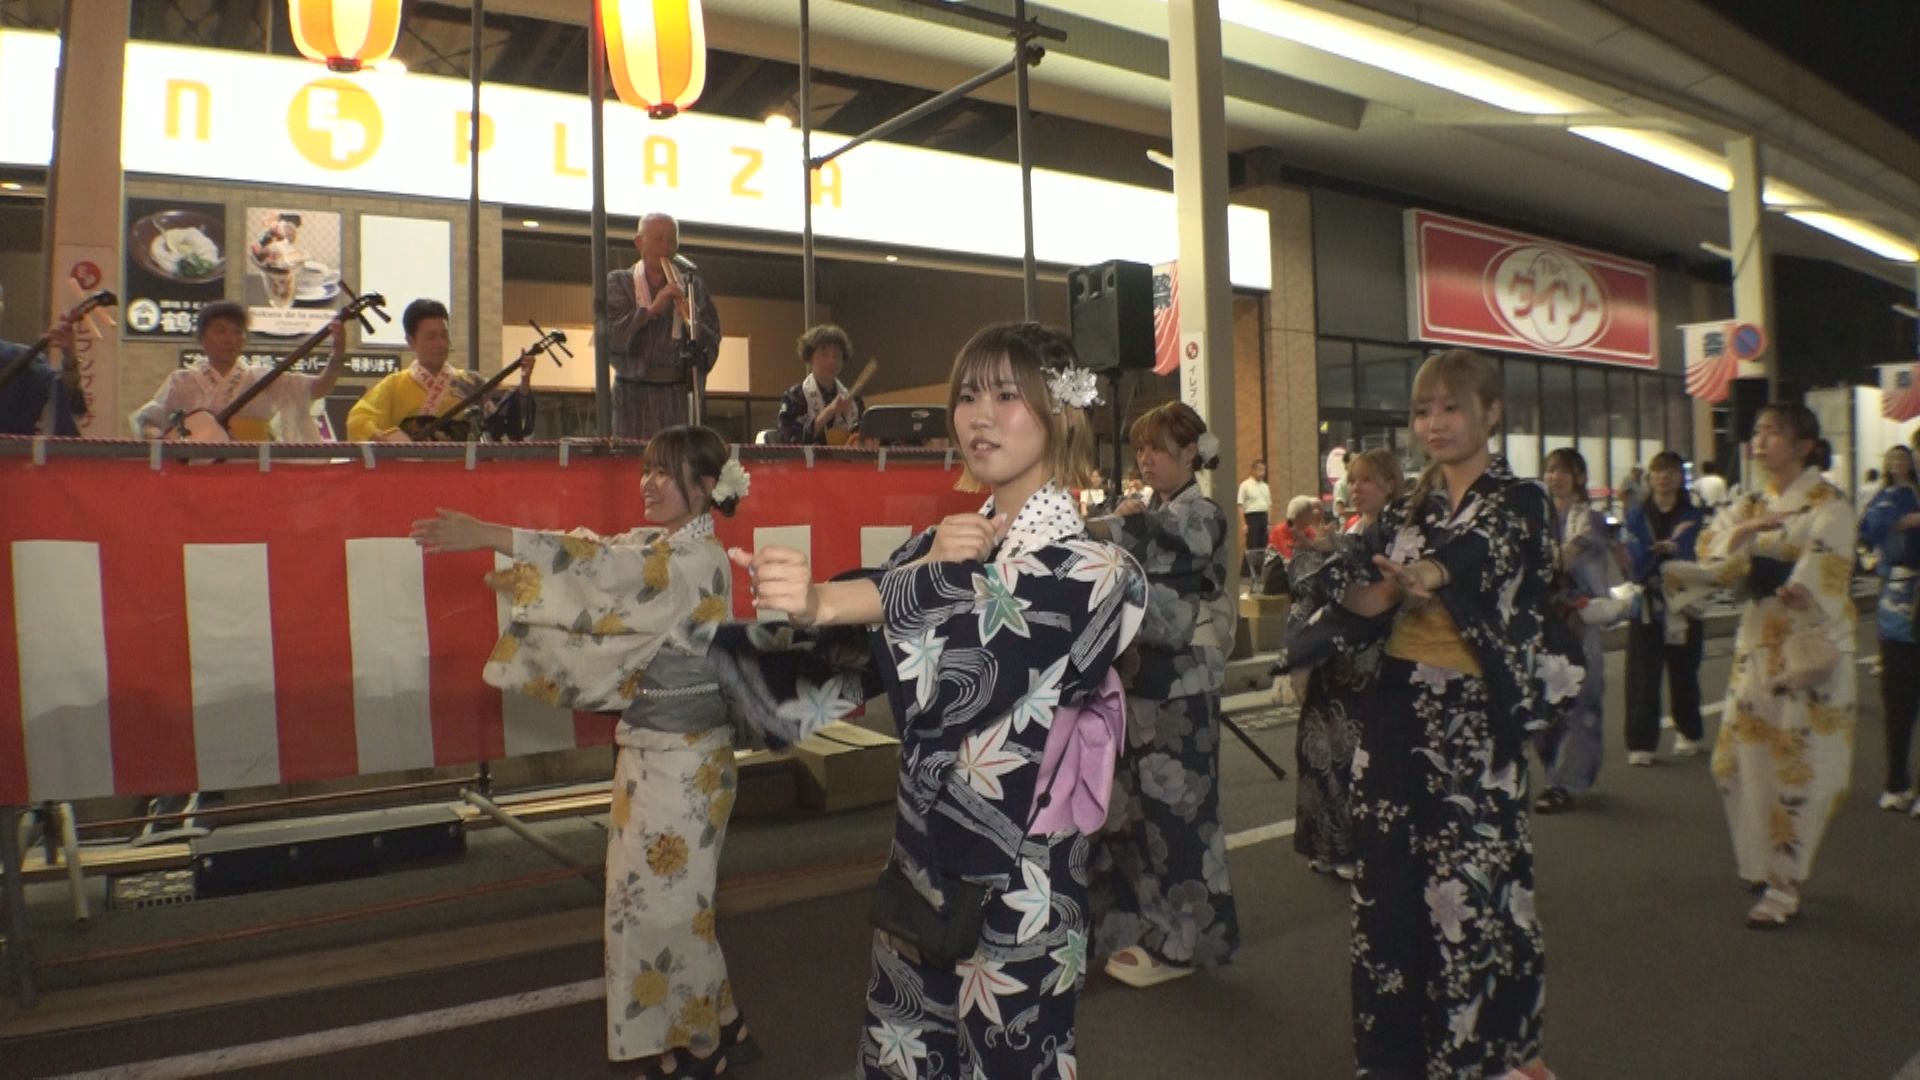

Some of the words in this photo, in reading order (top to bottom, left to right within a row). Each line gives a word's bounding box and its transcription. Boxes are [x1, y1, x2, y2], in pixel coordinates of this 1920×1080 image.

[455, 110, 841, 208] PLAZA
[1508, 271, 1600, 325] ダイソー
